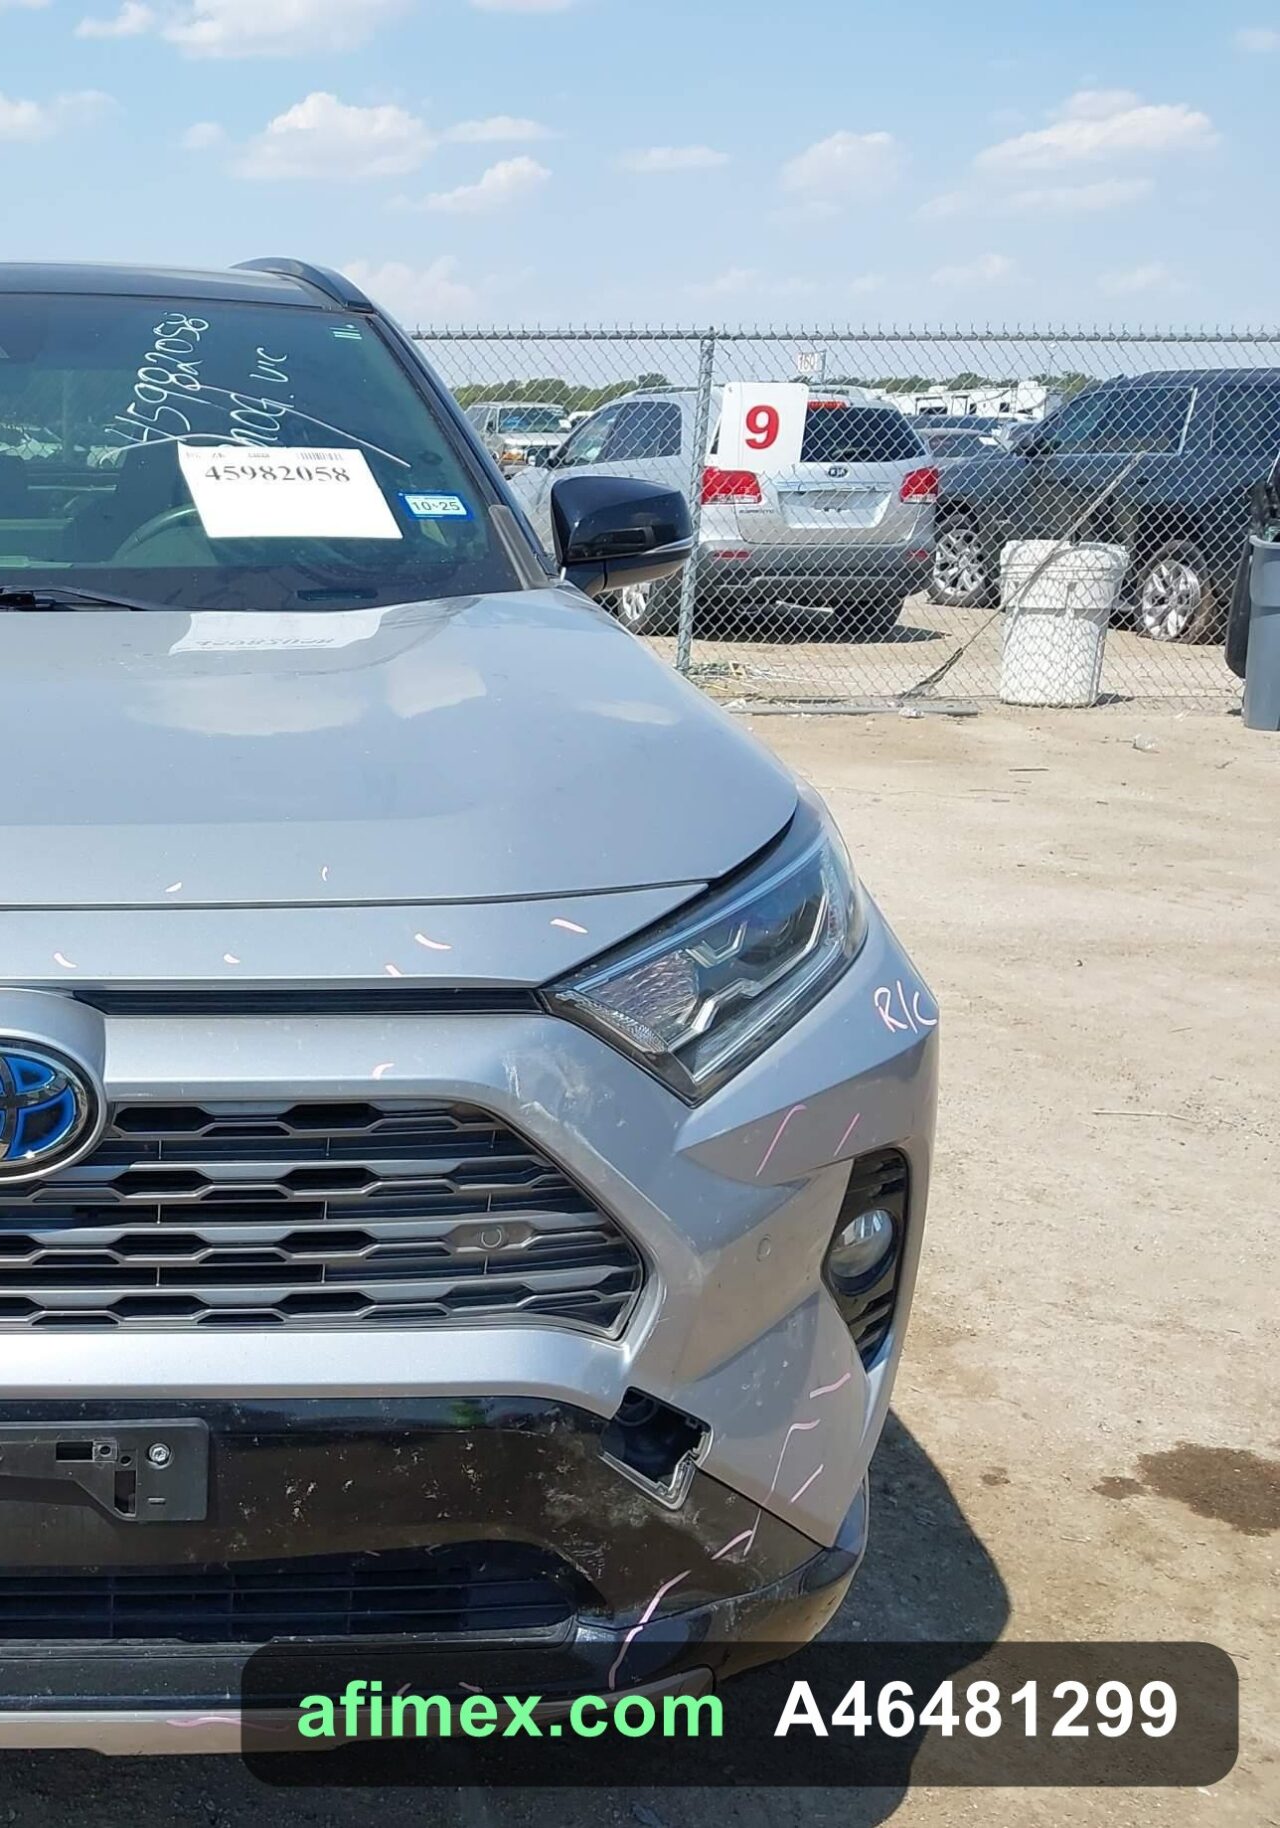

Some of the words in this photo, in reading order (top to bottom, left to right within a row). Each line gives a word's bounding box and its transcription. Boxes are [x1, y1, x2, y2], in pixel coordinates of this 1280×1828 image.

[104, 311, 209, 442] 45982058
[745, 404, 780, 450] 9
[205, 465, 351, 483] 45982058
[874, 980, 937, 1034] R/C
